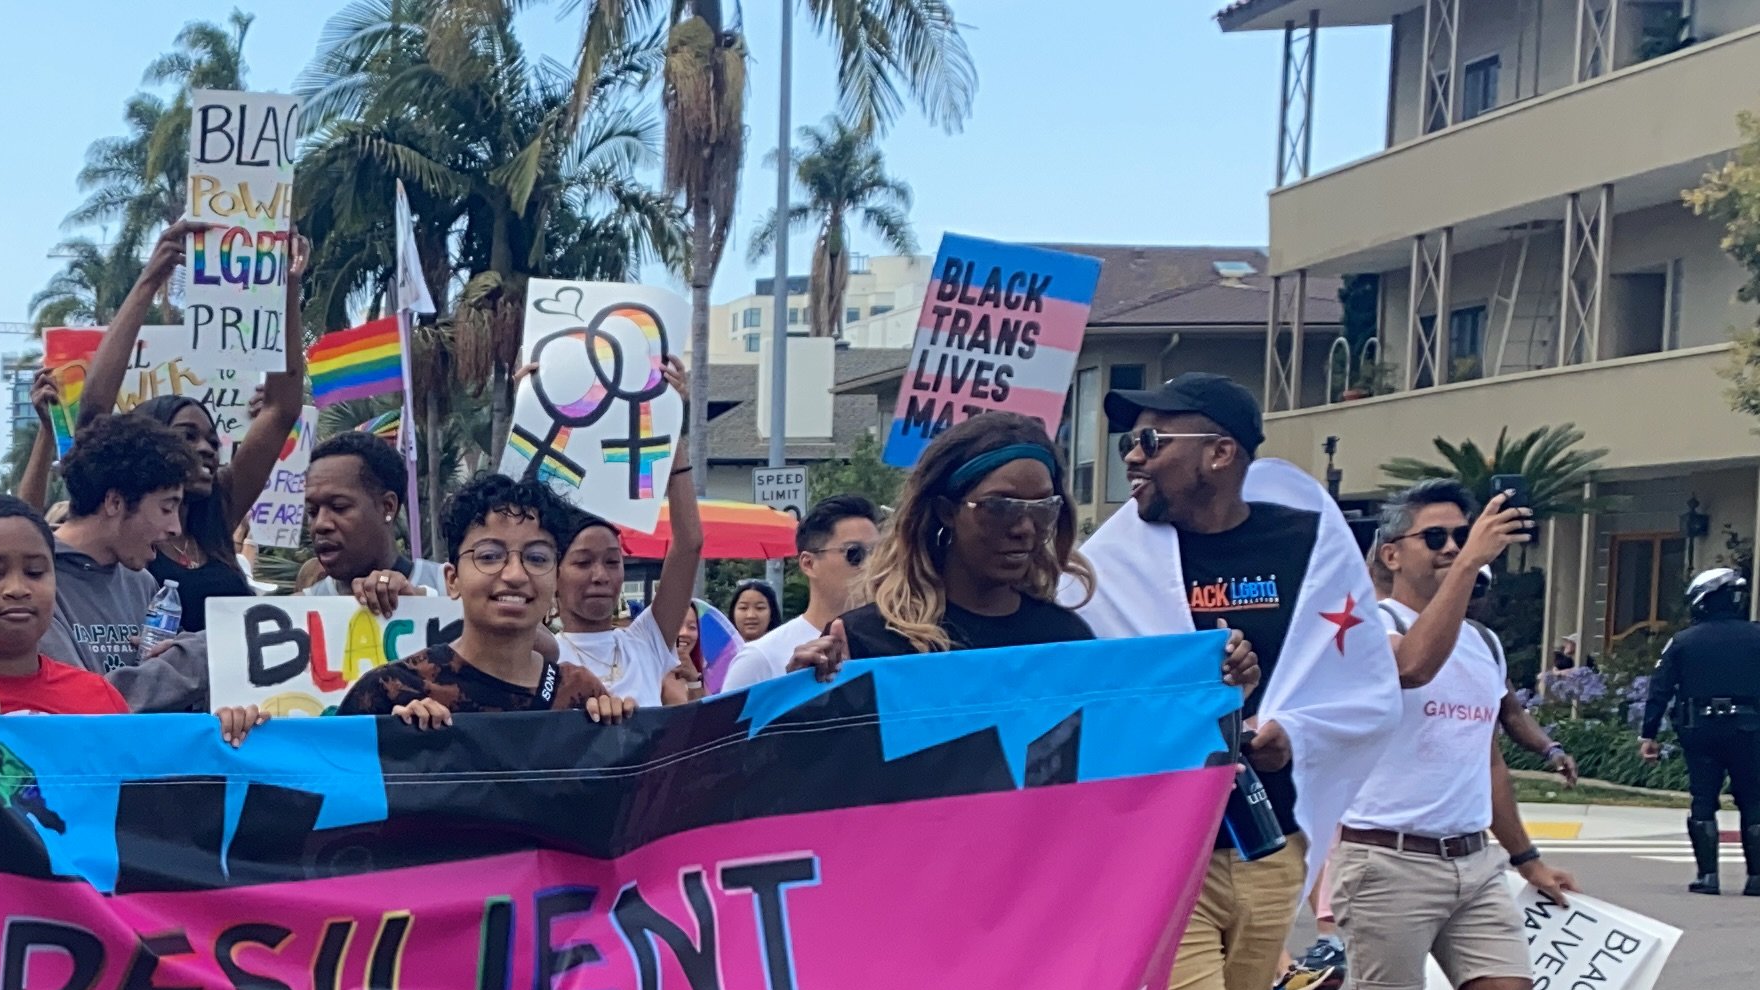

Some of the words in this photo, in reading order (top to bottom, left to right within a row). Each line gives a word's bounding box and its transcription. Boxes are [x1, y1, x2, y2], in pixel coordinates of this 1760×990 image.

[194, 103, 299, 168] BLAC
[936, 256, 1054, 313] BLACK
[188, 304, 283, 354] PRID
[930, 305, 1041, 360] TRANS
[912, 349, 1015, 403] LIVES
[201, 387, 246, 413] ALL
[215, 413, 244, 434] he
[757, 473, 804, 486] SPEED
[762, 489, 800, 501] LIMIT
[1191, 582, 1230, 607] ACK
[541, 663, 556, 701] SONY
[1423, 700, 1495, 723] GAYSIAN
